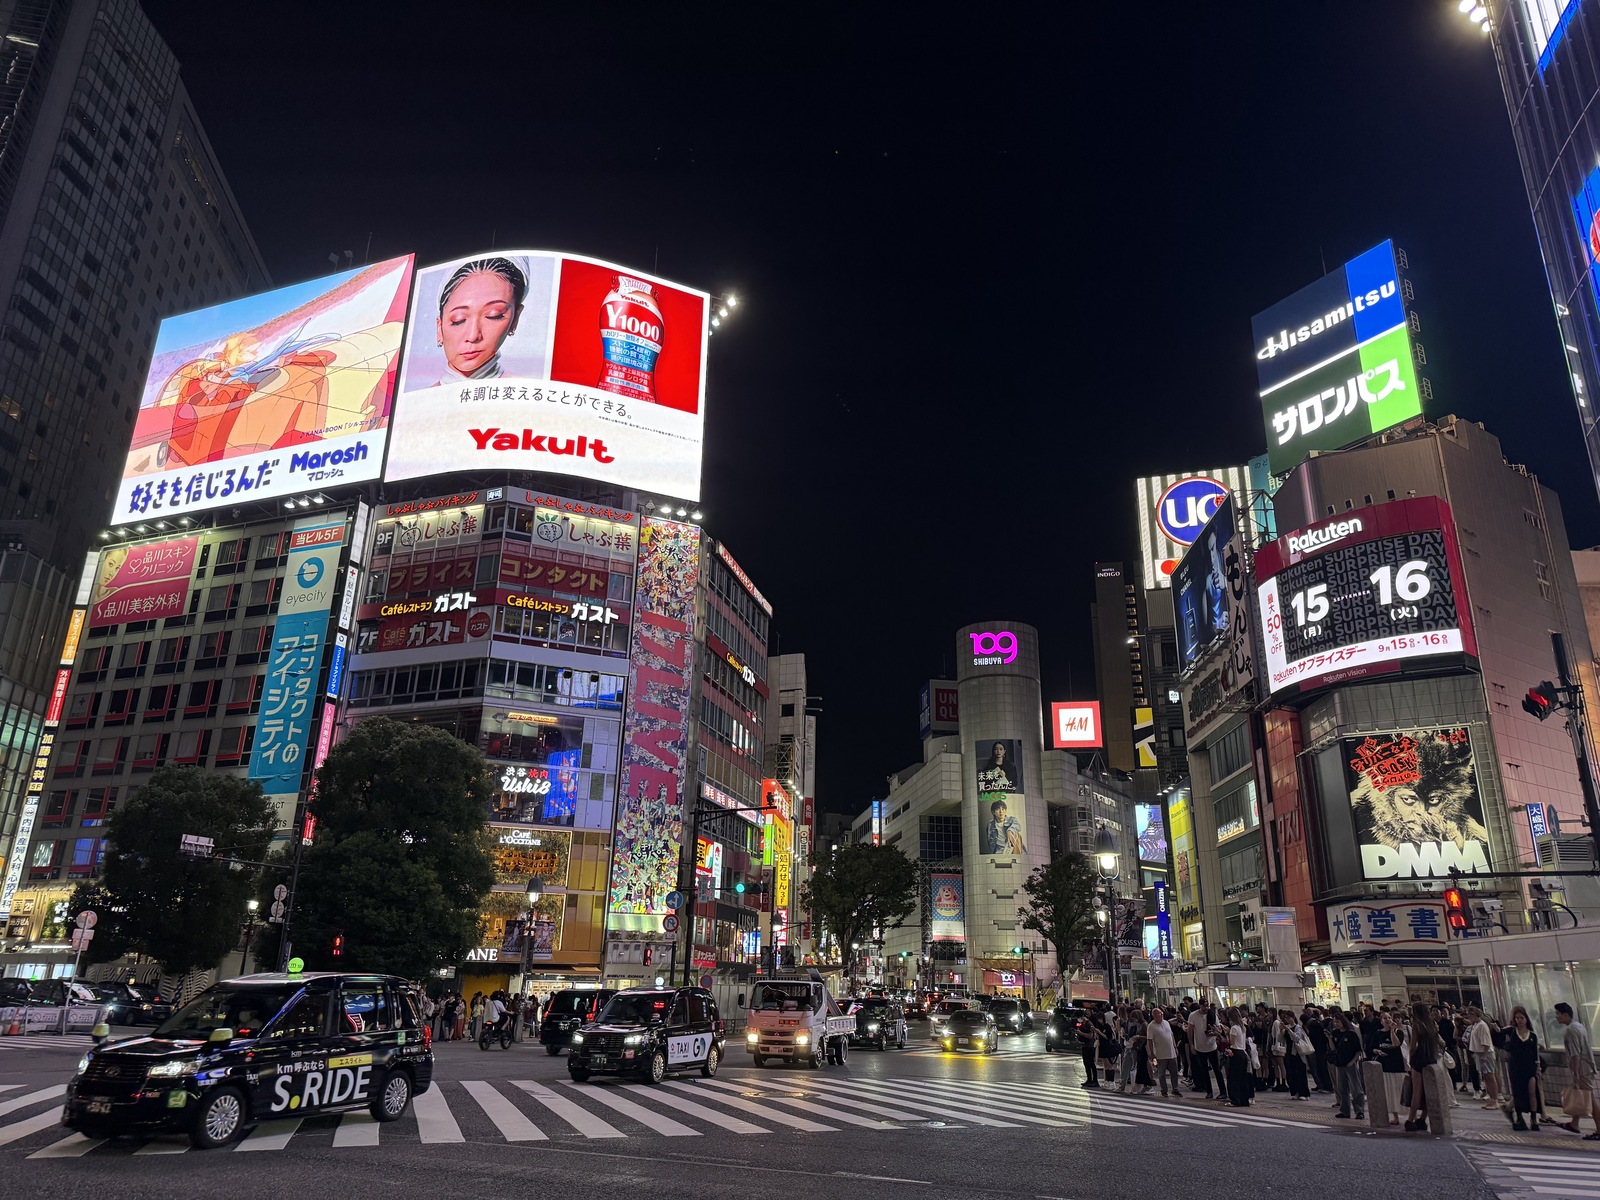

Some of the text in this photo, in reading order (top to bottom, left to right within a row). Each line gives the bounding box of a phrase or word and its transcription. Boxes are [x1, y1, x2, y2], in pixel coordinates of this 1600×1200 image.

[620, 294, 650, 308] Yakult
[606, 304, 660, 342] Y1000
[1257, 280, 1396, 361] Hisamitsu
[460, 385, 632, 420] 体調は変えることができる。
[1272, 358, 1406, 446] サロンパス
[289, 442, 368, 473] Marosh
[467, 428, 615, 464] Yakult
[128, 458, 280, 514] 好きを信じるんだ
[307, 468, 344, 482] マロッシュ
[387, 492, 479, 517] しゃぶしゃぶバイキング
[526, 491, 635, 523] しゃぶしゃぶバイキング
[295, 527, 340, 547] 当ビル5F
[377, 532, 394, 546] 9F
[424, 515, 479, 541] しゃぶ葉
[569, 523, 633, 552] しゃぶ葉
[1288, 518, 1363, 554] Rakuten
[143, 545, 192, 564] 品川スキン
[1326, 548, 1406, 577] SURPRISE
[1410, 542, 1445, 558] DAY
[140, 560, 184, 578] クリニック
[390, 559, 475, 590] プライス
[501, 558, 604, 592] コンタクト
[1369, 560, 1430, 606] 16
[103, 592, 181, 618] 品川美容外科
[286, 589, 328, 607] eyecity
[381, 591, 477, 616] Caféレストラン ガスト
[507, 595, 620, 625] Caféレストラン ガスト
[1226, 545, 1252, 677] もんじゃ
[1291, 583, 1330, 627] 15
[360, 631, 379, 647] 7F
[383, 627, 406, 640] Café
[406, 620, 460, 647] ガスト
[970, 631, 1018, 664] 109
[1271, 642, 1283, 655] OFF
[973, 657, 1002, 666] SHIBUYA
[1273, 645, 1367, 683] Rakuten サプライズデー
[1323, 667, 1367, 684] Rakuten Vision
[259, 635, 301, 765] アイシティ
[281, 633, 319, 764] コンタクトの
[1064, 717, 1089, 732] H&M
[500, 776, 552, 795] Ushi8
[980, 791, 1007, 801] JACCS
[20, 818, 32, 835] 内科
[500, 836, 541, 846] L'OCCITANE
[1361, 840, 1495, 878] DMM
[738, 912, 755, 929] LUSH
[677, 1042, 690, 1053] TAXI
[693, 1036, 706, 1058] GO
